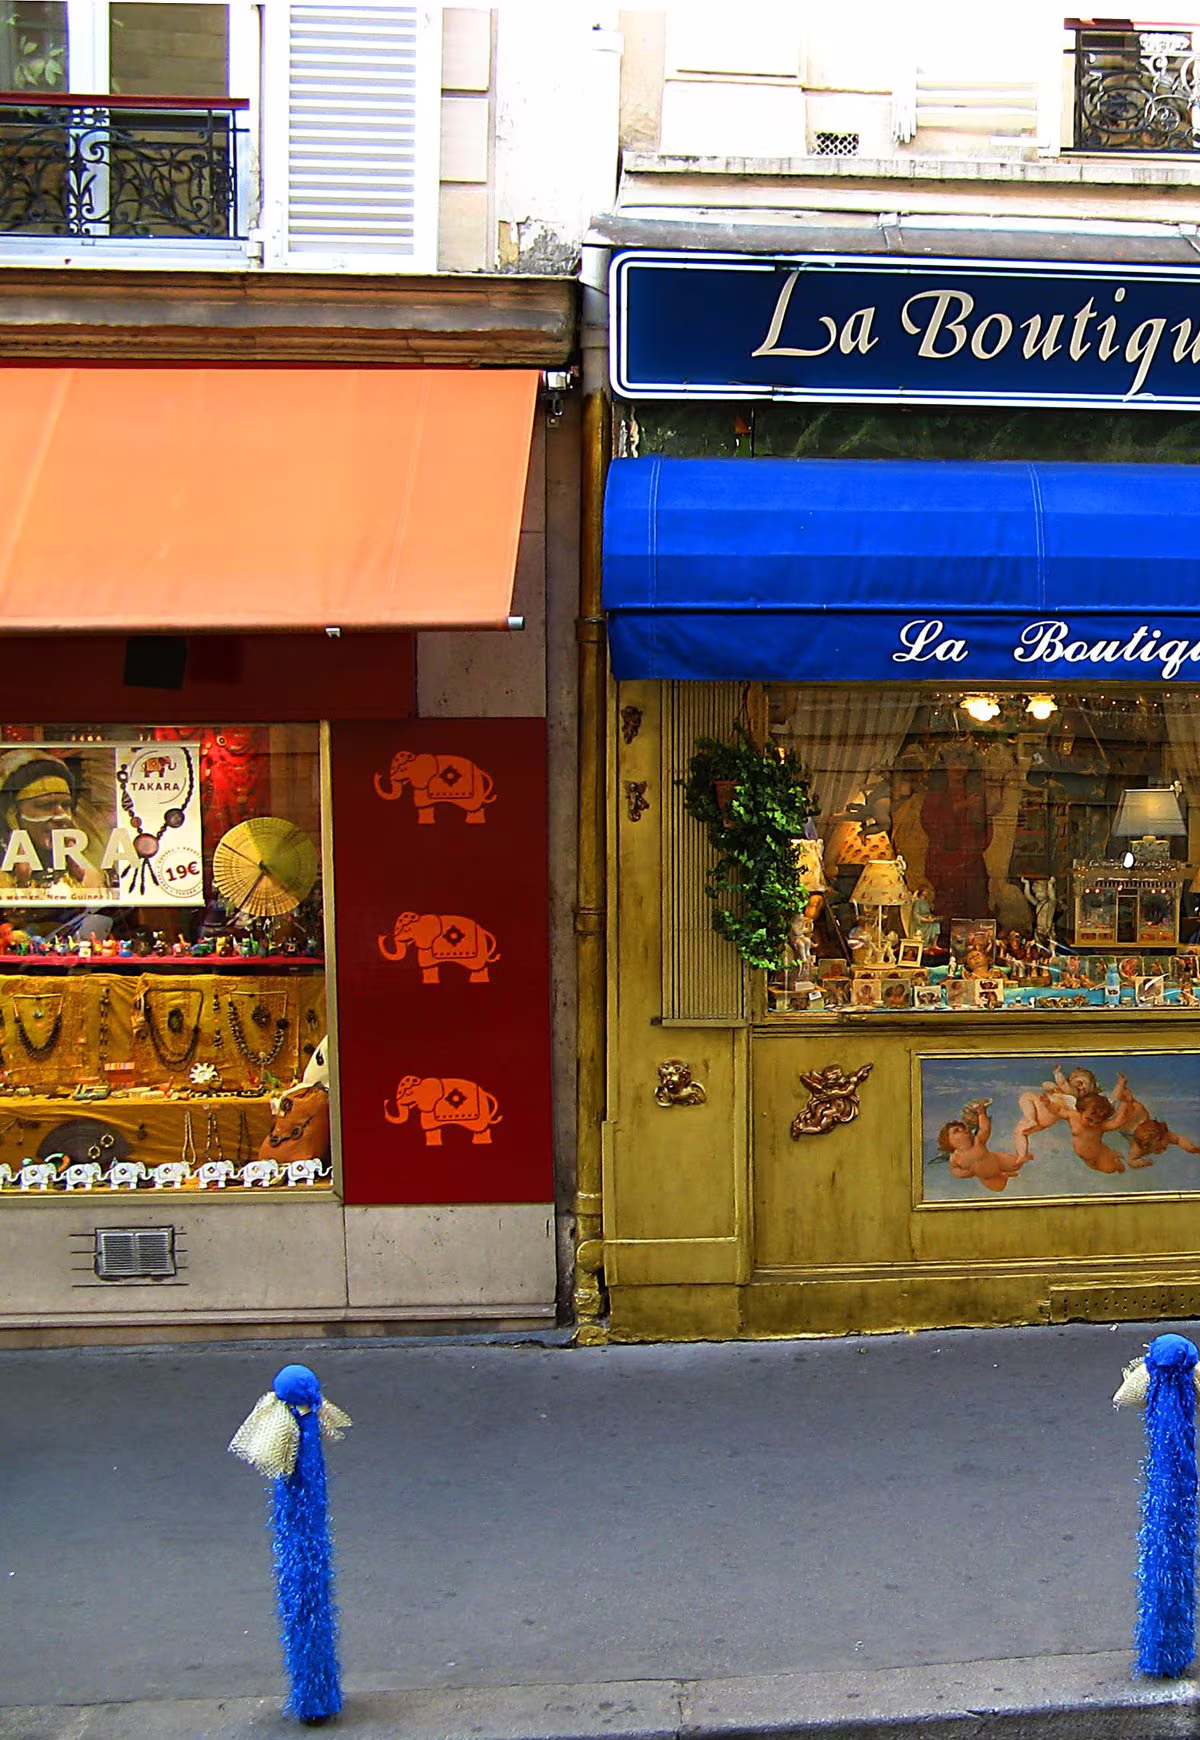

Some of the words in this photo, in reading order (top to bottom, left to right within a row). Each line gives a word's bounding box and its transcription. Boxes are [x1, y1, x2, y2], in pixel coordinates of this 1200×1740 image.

[752, 264, 879, 357] La
[892, 620, 968, 662] La
[130, 781, 181, 792] TAKARA
[165, 860, 201, 882] 19€
